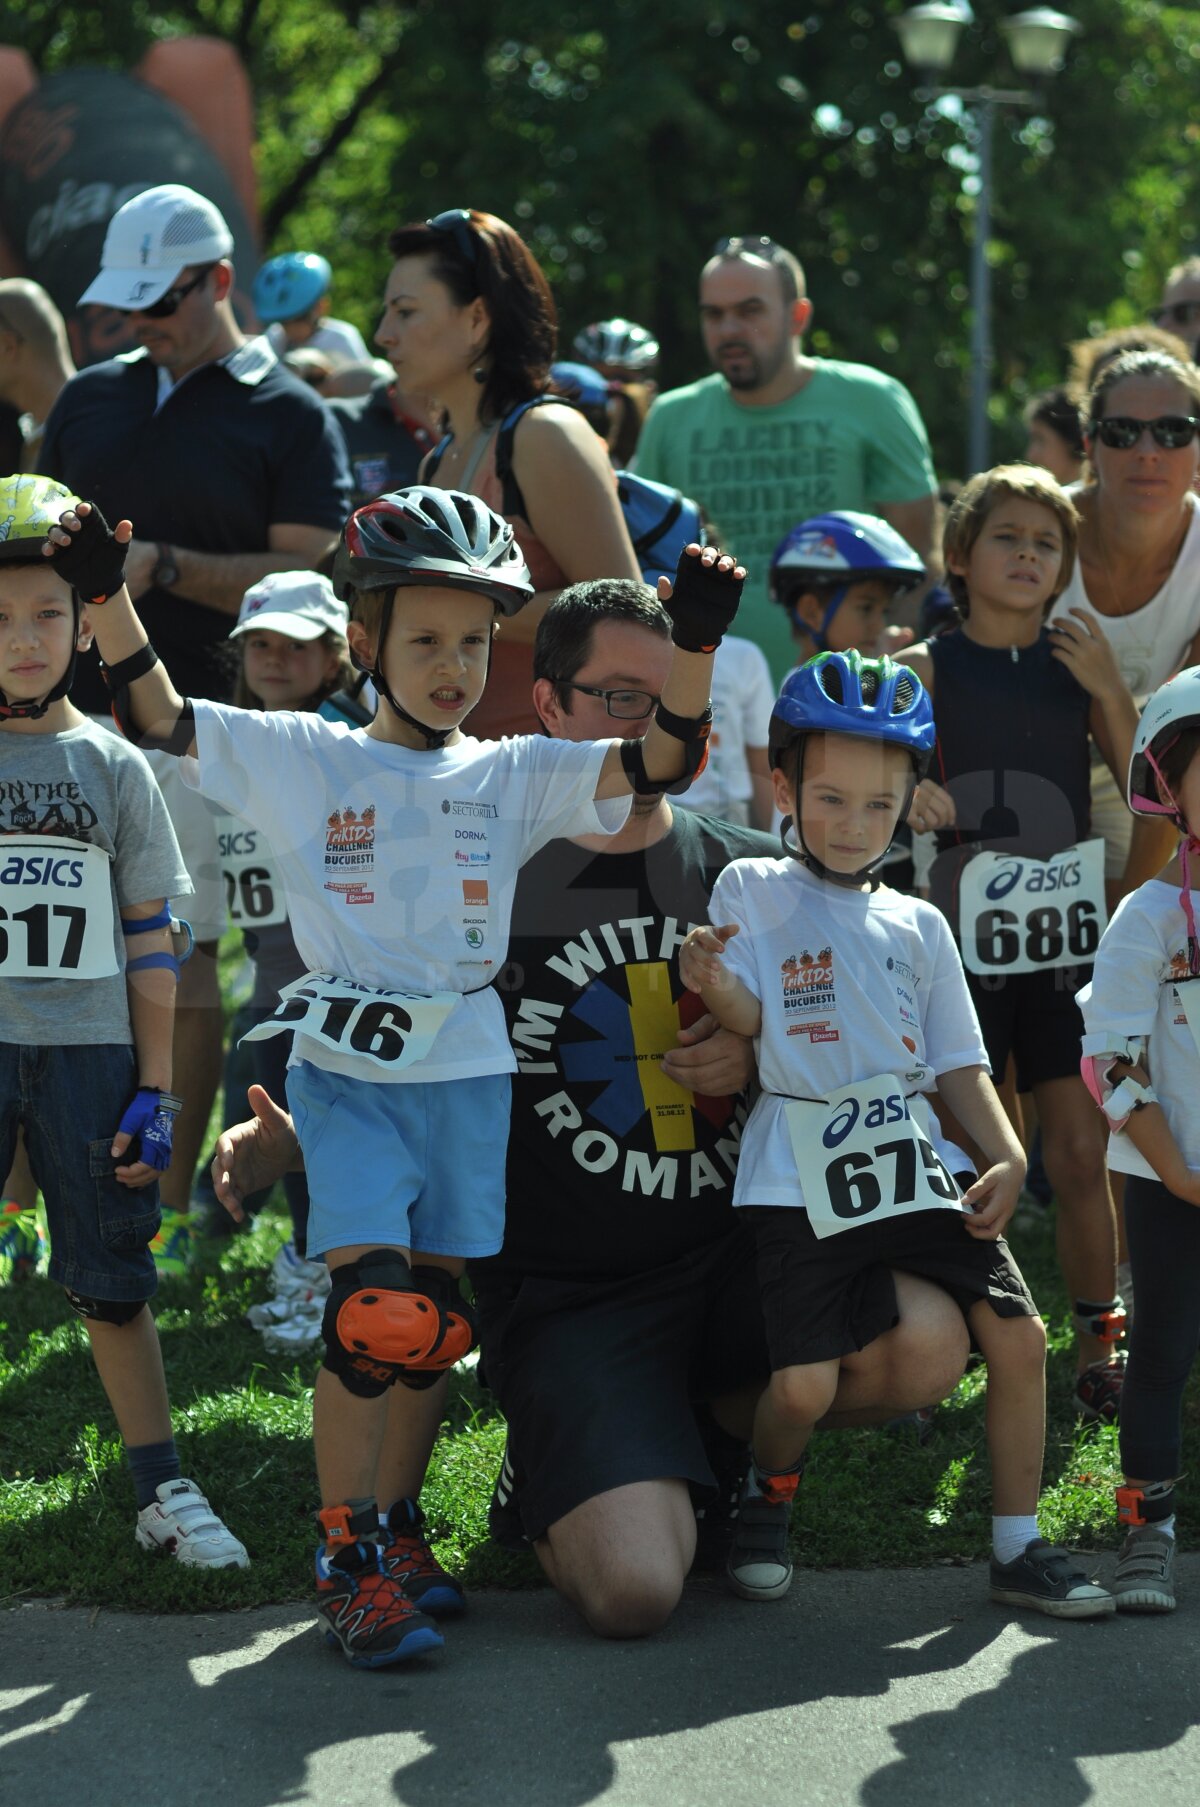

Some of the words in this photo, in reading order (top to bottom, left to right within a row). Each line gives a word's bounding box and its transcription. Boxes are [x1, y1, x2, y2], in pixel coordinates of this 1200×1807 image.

[326, 842, 374, 852] CHALLENGE
[455, 830, 488, 840] DORNA
[545, 916, 704, 987] WITH
[975, 900, 1099, 966] 686
[784, 983, 834, 996] CHALLENGE
[825, 1138, 959, 1219] 675
